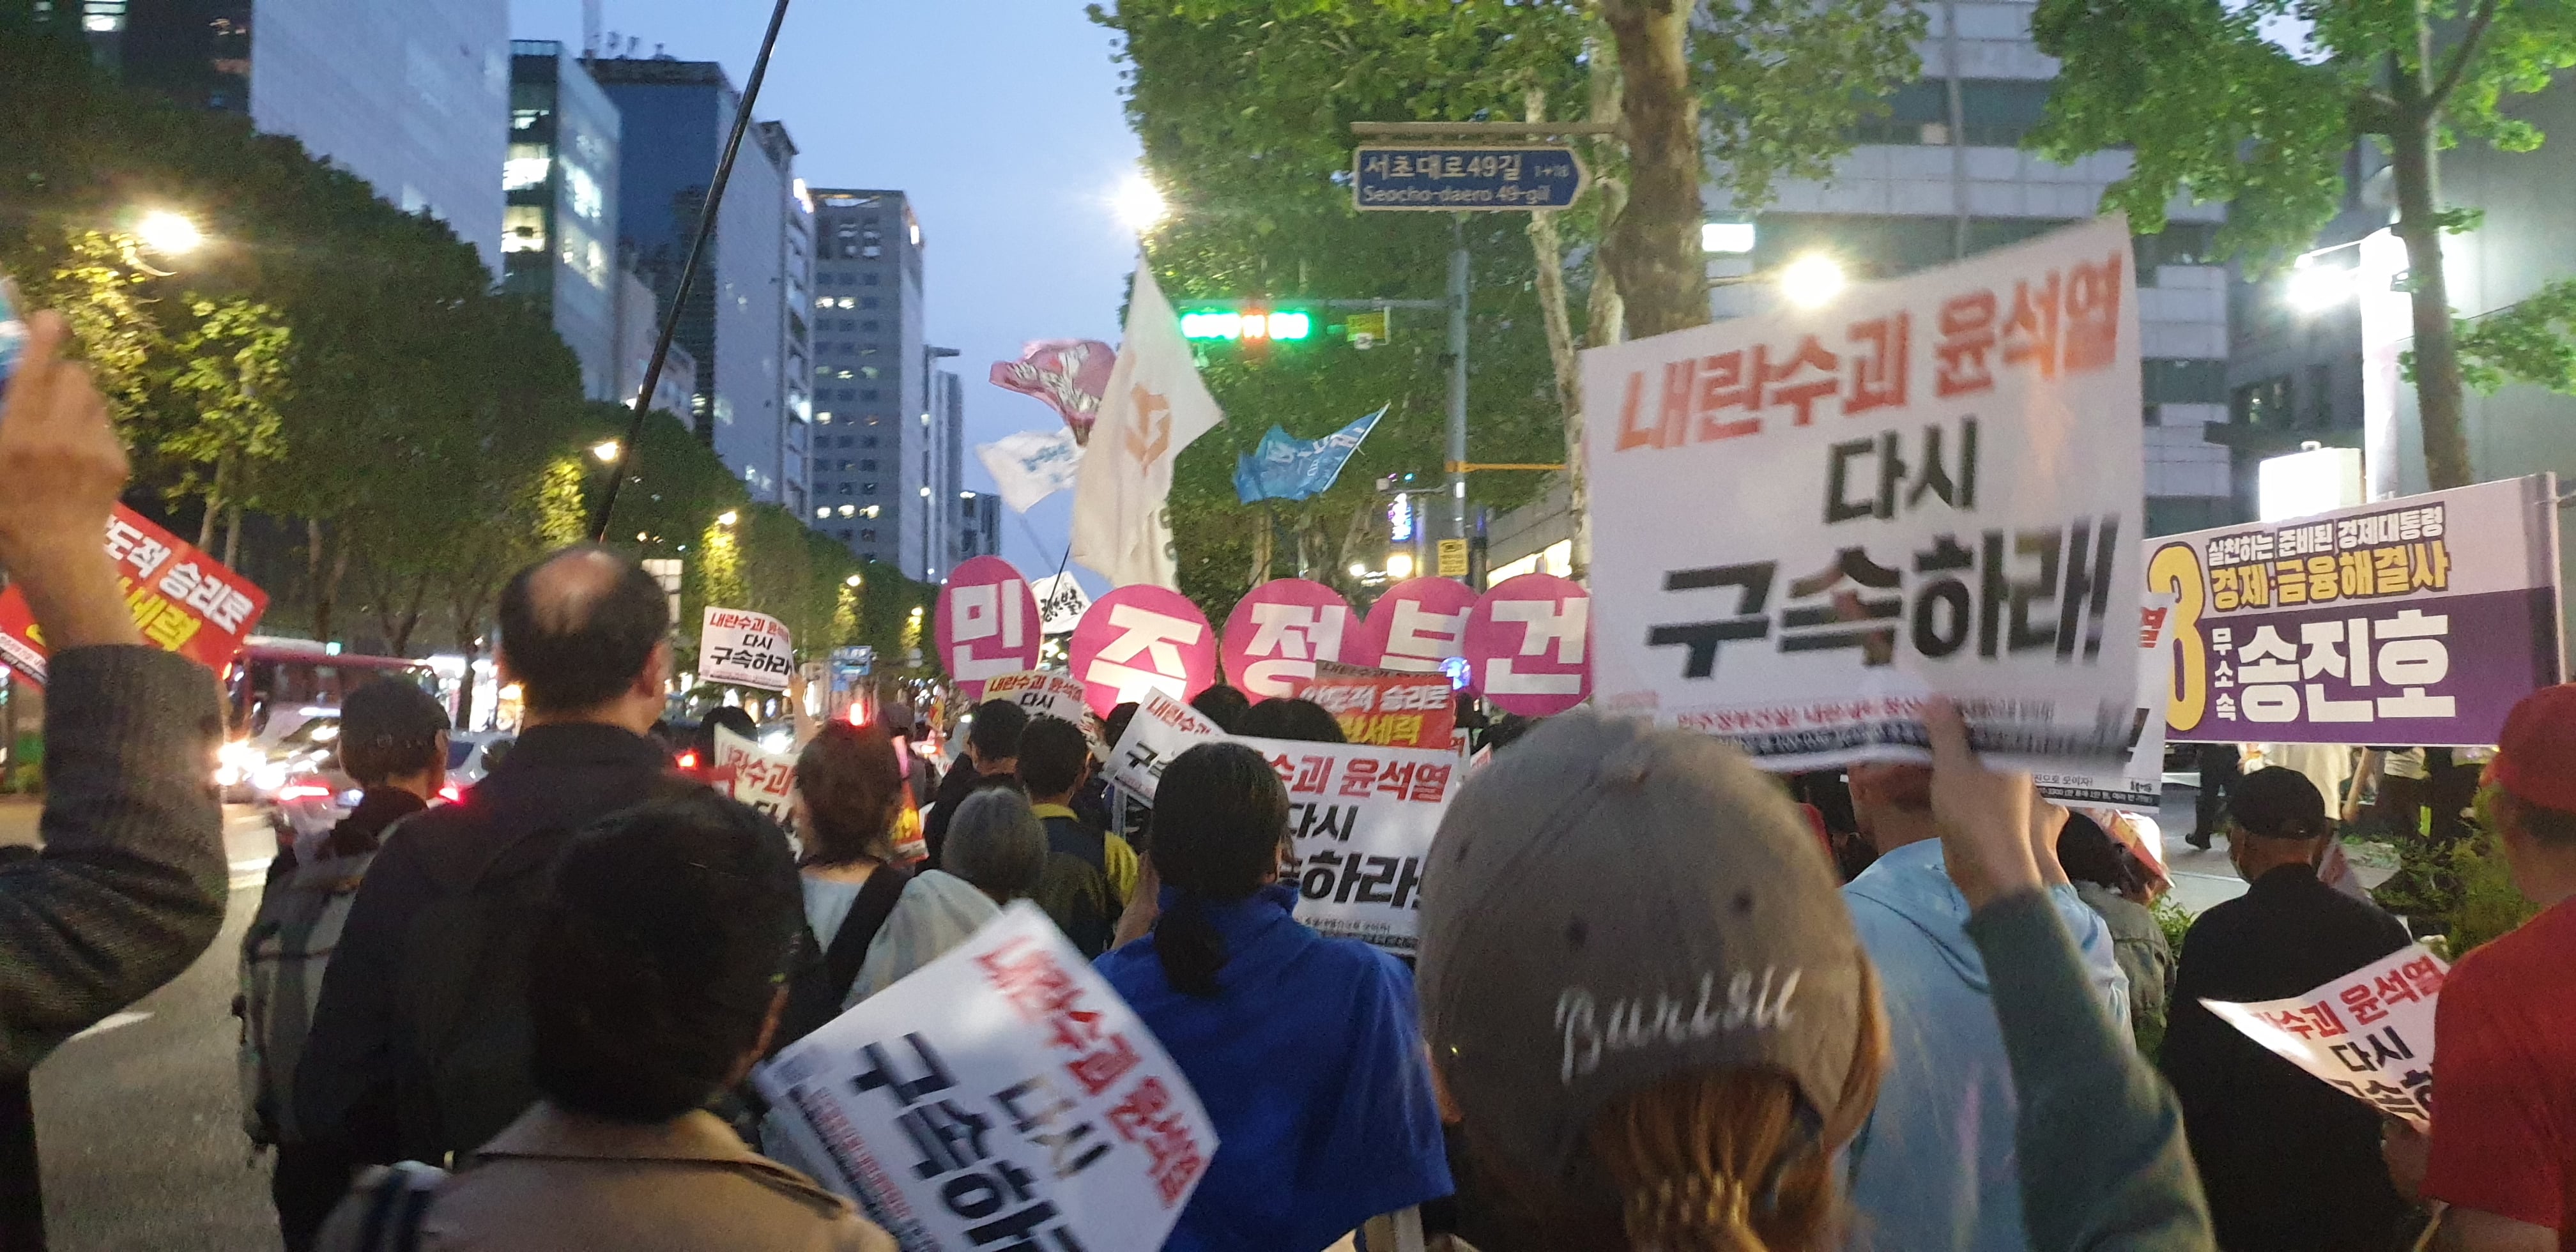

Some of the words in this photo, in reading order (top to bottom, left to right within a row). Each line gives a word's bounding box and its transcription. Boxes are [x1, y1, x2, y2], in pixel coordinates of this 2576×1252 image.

[1365, 154, 1522, 181] 서초대로49길
[1363, 185, 1494, 202] Seocho-daero
[1616, 312, 1912, 452] 내란수괴
[1933, 254, 2122, 399] 윤석열
[1823, 416, 1981, 524] 다시
[2208, 534, 2274, 566] 실천하는
[2278, 523, 2333, 558] 준비된
[2337, 506, 2444, 549] 경제대통령
[160, 562, 254, 635] 승리로
[709, 613, 765, 632] 내란수괴
[742, 633, 773, 650] 다시
[989, 675, 1047, 692] 내란수괴
[2212, 627, 2236, 721] 무소속
[2237, 609, 2455, 723] 송진호
[1019, 692, 1055, 709] 다시
[1380, 684, 1451, 712] 승리로
[1338, 758, 1452, 803] 윤석열
[1289, 801, 1359, 842] 다시
[2340, 954, 2447, 1025] 윤석열
[974, 935, 1140, 1097] 내란수괴
[1105, 1075, 1208, 1209] 윤석열
[2329, 1025, 2415, 1073] 다시
[990, 1073, 1117, 1179] 다시
